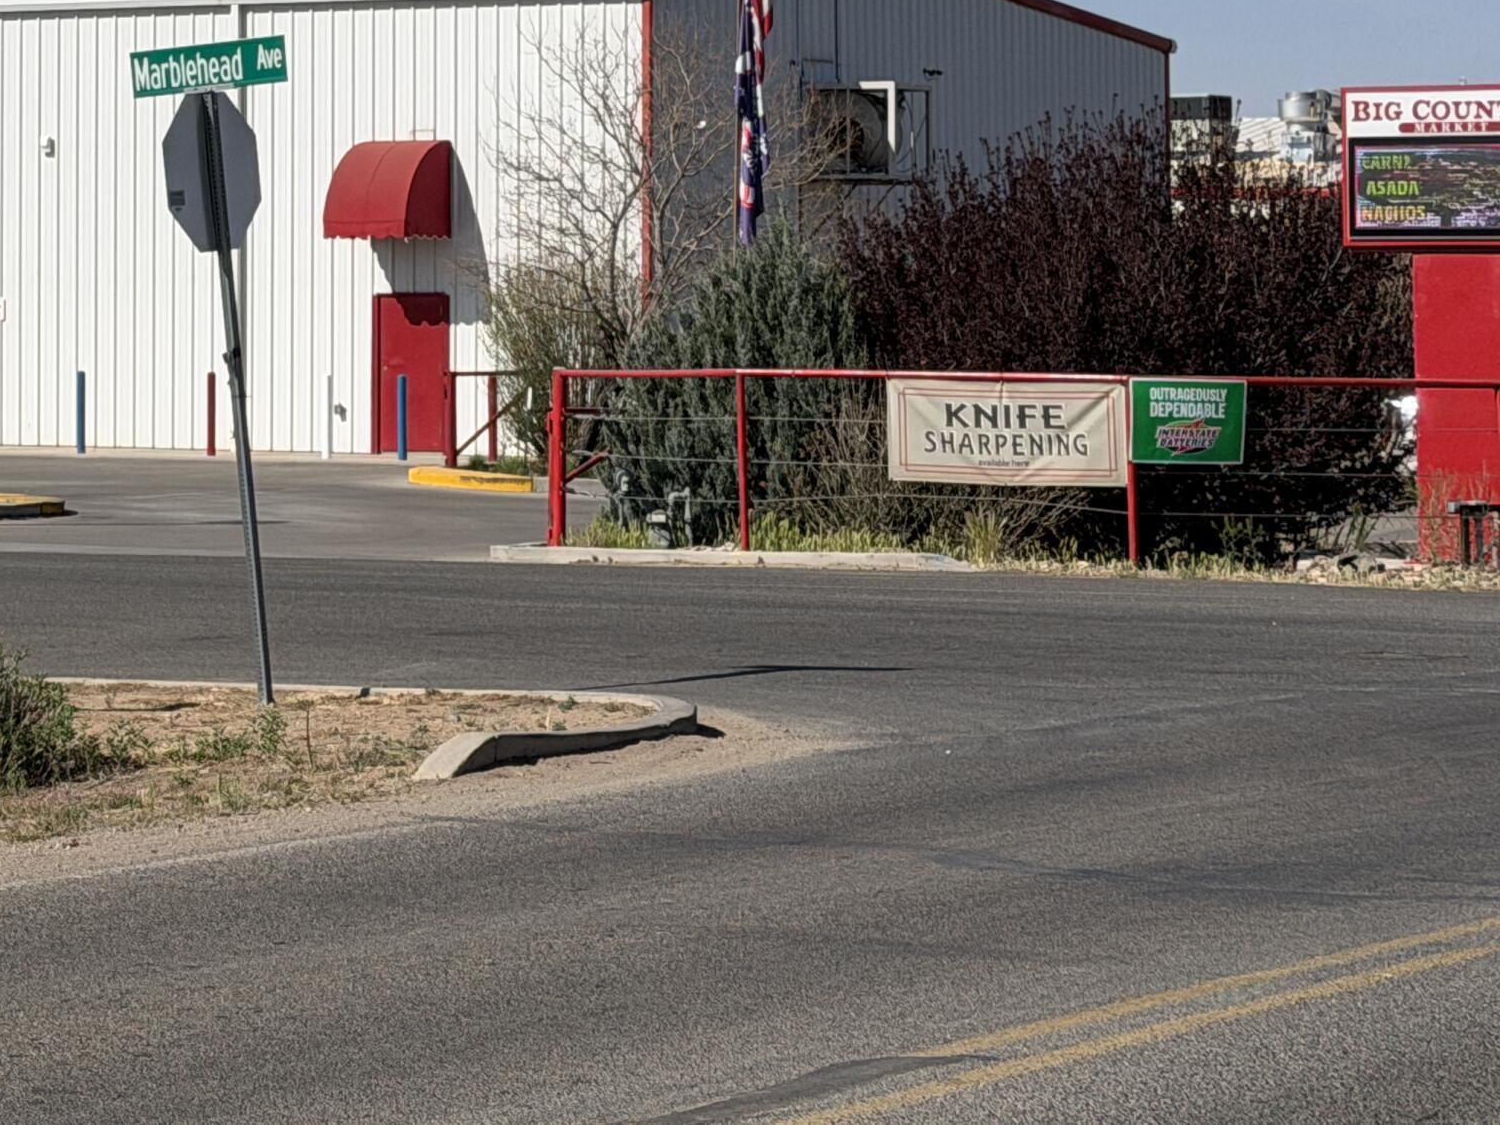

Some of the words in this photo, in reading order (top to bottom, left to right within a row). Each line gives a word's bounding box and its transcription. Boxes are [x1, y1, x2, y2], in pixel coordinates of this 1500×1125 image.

[134, 47, 243, 91] Marblehead
[257, 44, 282, 70] Ave
[1352, 100, 1403, 121] BIG
[1412, 100, 1500, 120] COUN
[1414, 122, 1489, 133] MARKET
[1366, 181, 1419, 195] ASADA
[1149, 387, 1227, 401] OUTRAGEOUSLY
[945, 403, 1066, 429] KNIFE
[1149, 403, 1226, 418] DEPENDABLE
[1156, 428, 1220, 438] INTERSTATE
[924, 431, 1088, 456] SHARPENING
[1158, 438, 1214, 448] BATTERIES
